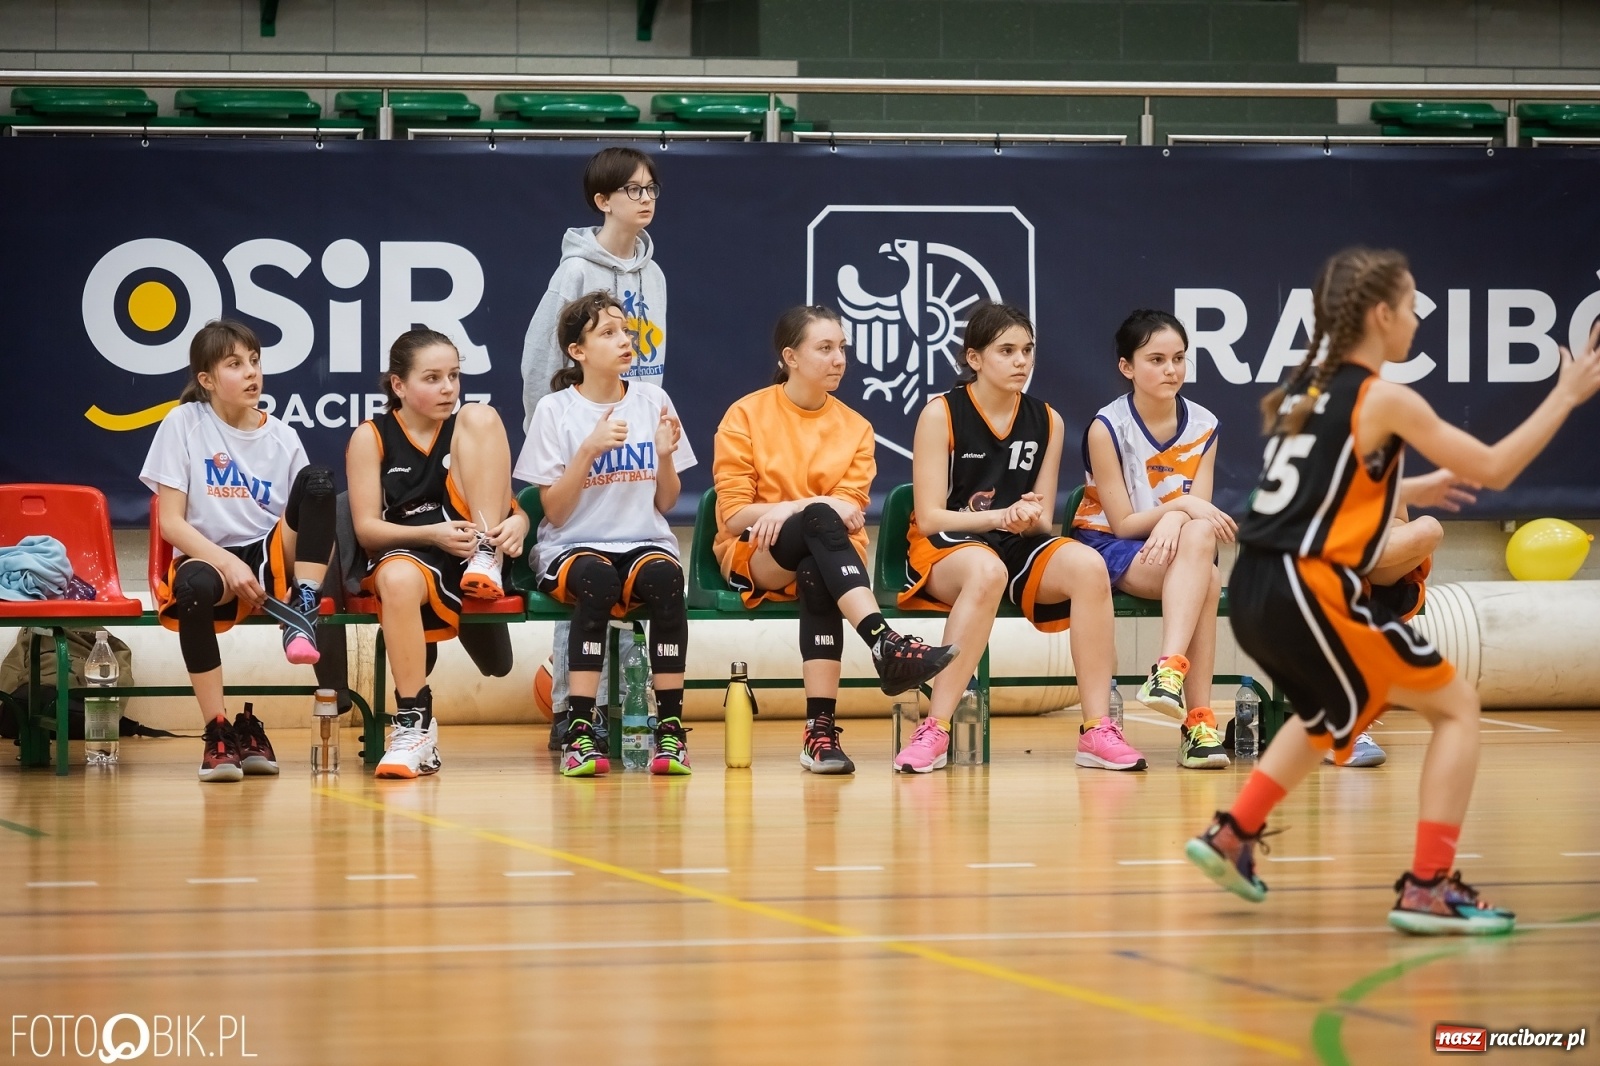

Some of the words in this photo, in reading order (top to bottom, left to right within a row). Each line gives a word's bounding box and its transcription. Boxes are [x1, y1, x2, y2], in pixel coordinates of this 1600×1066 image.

[82, 238, 492, 375] OSiR
[1008, 440, 1039, 471] 13
[820, 635, 834, 646] NBA
[589, 642, 602, 655] NBA
[663, 643, 679, 657] NBA
